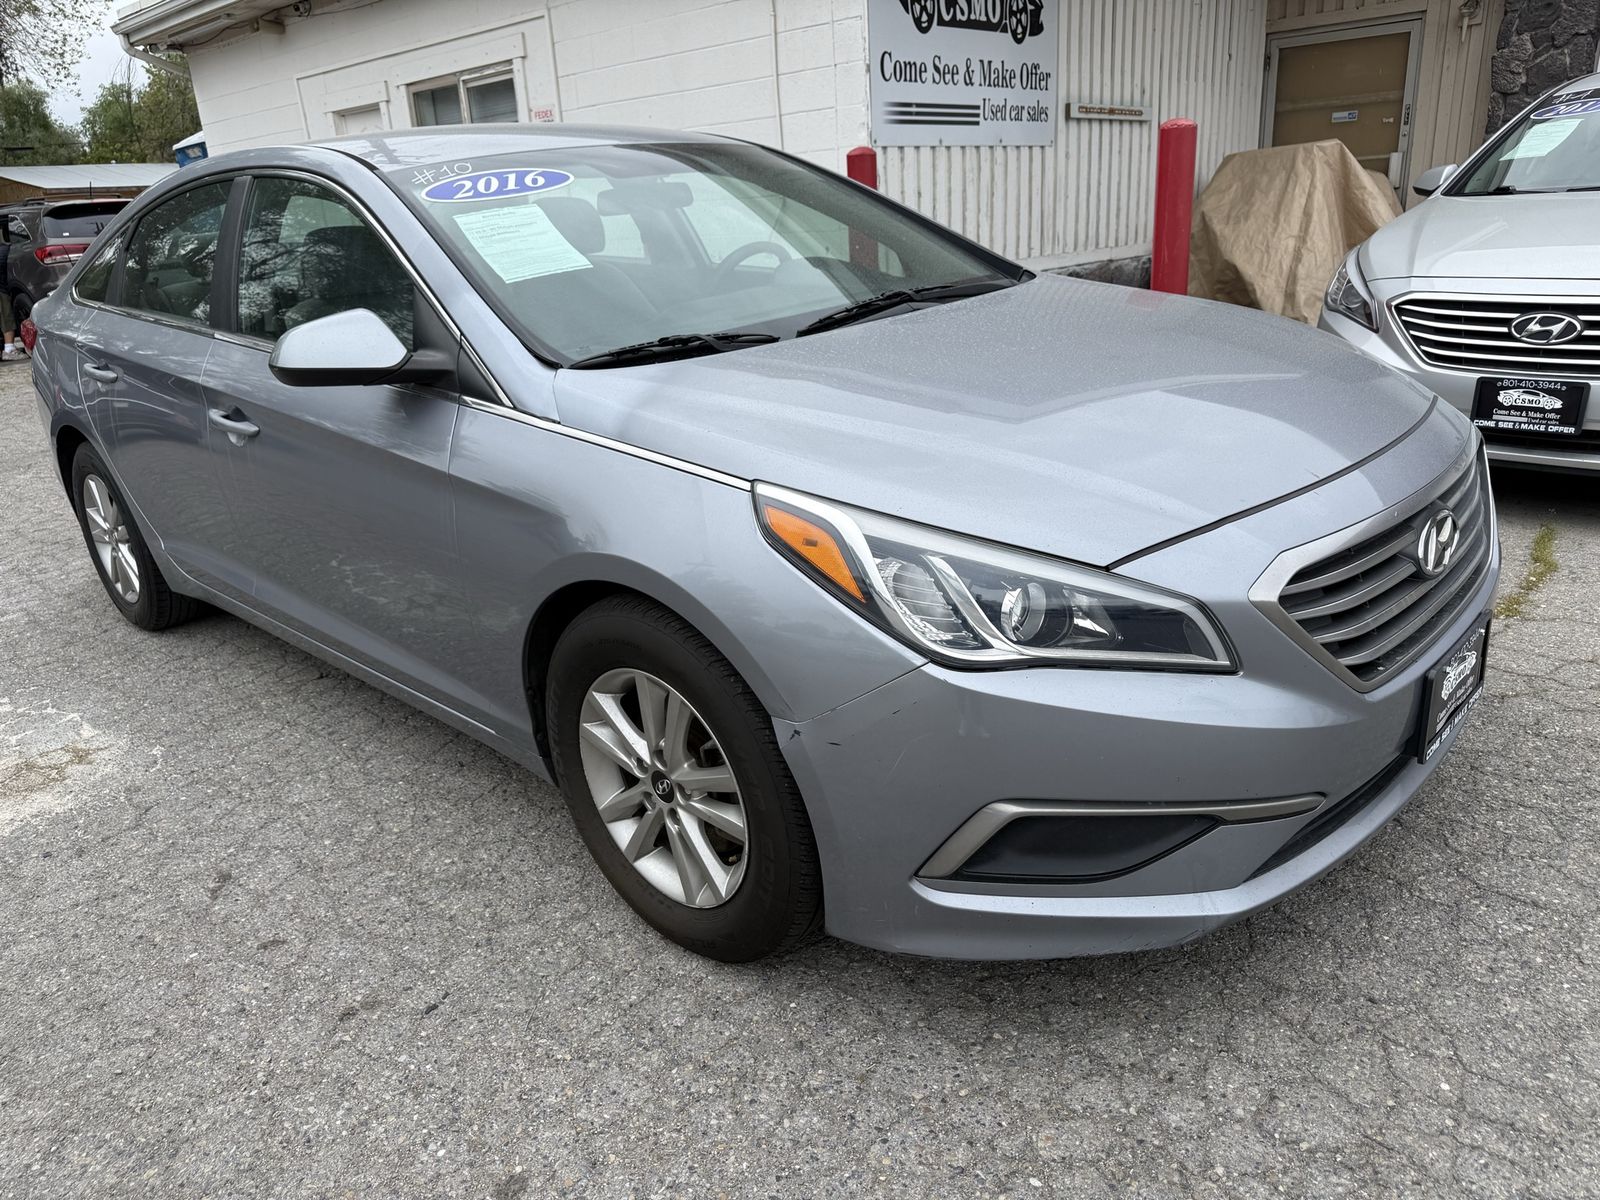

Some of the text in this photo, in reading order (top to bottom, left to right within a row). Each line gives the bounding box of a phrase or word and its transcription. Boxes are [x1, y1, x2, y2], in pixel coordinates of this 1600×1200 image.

[939, 0, 1001, 24] CSMO
[880, 51, 1051, 91] Come See & Make Offer
[982, 98, 1049, 123] Used car sales
[411, 162, 472, 186] #10
[452, 171, 546, 199] 2016
[1502, 379, 1561, 389] 801-410-3944
[1514, 397, 1541, 406] CSMO
[1493, 408, 1509, 416] Come
[1510, 409, 1521, 417] See
[1528, 411, 1544, 419] Make
[1545, 412, 1561, 420] Offer
[1473, 419, 1496, 427] COME
[1498, 421, 1514, 429] SEE
[1520, 423, 1546, 432] MAKE
[1548, 425, 1576, 434] OFFER
